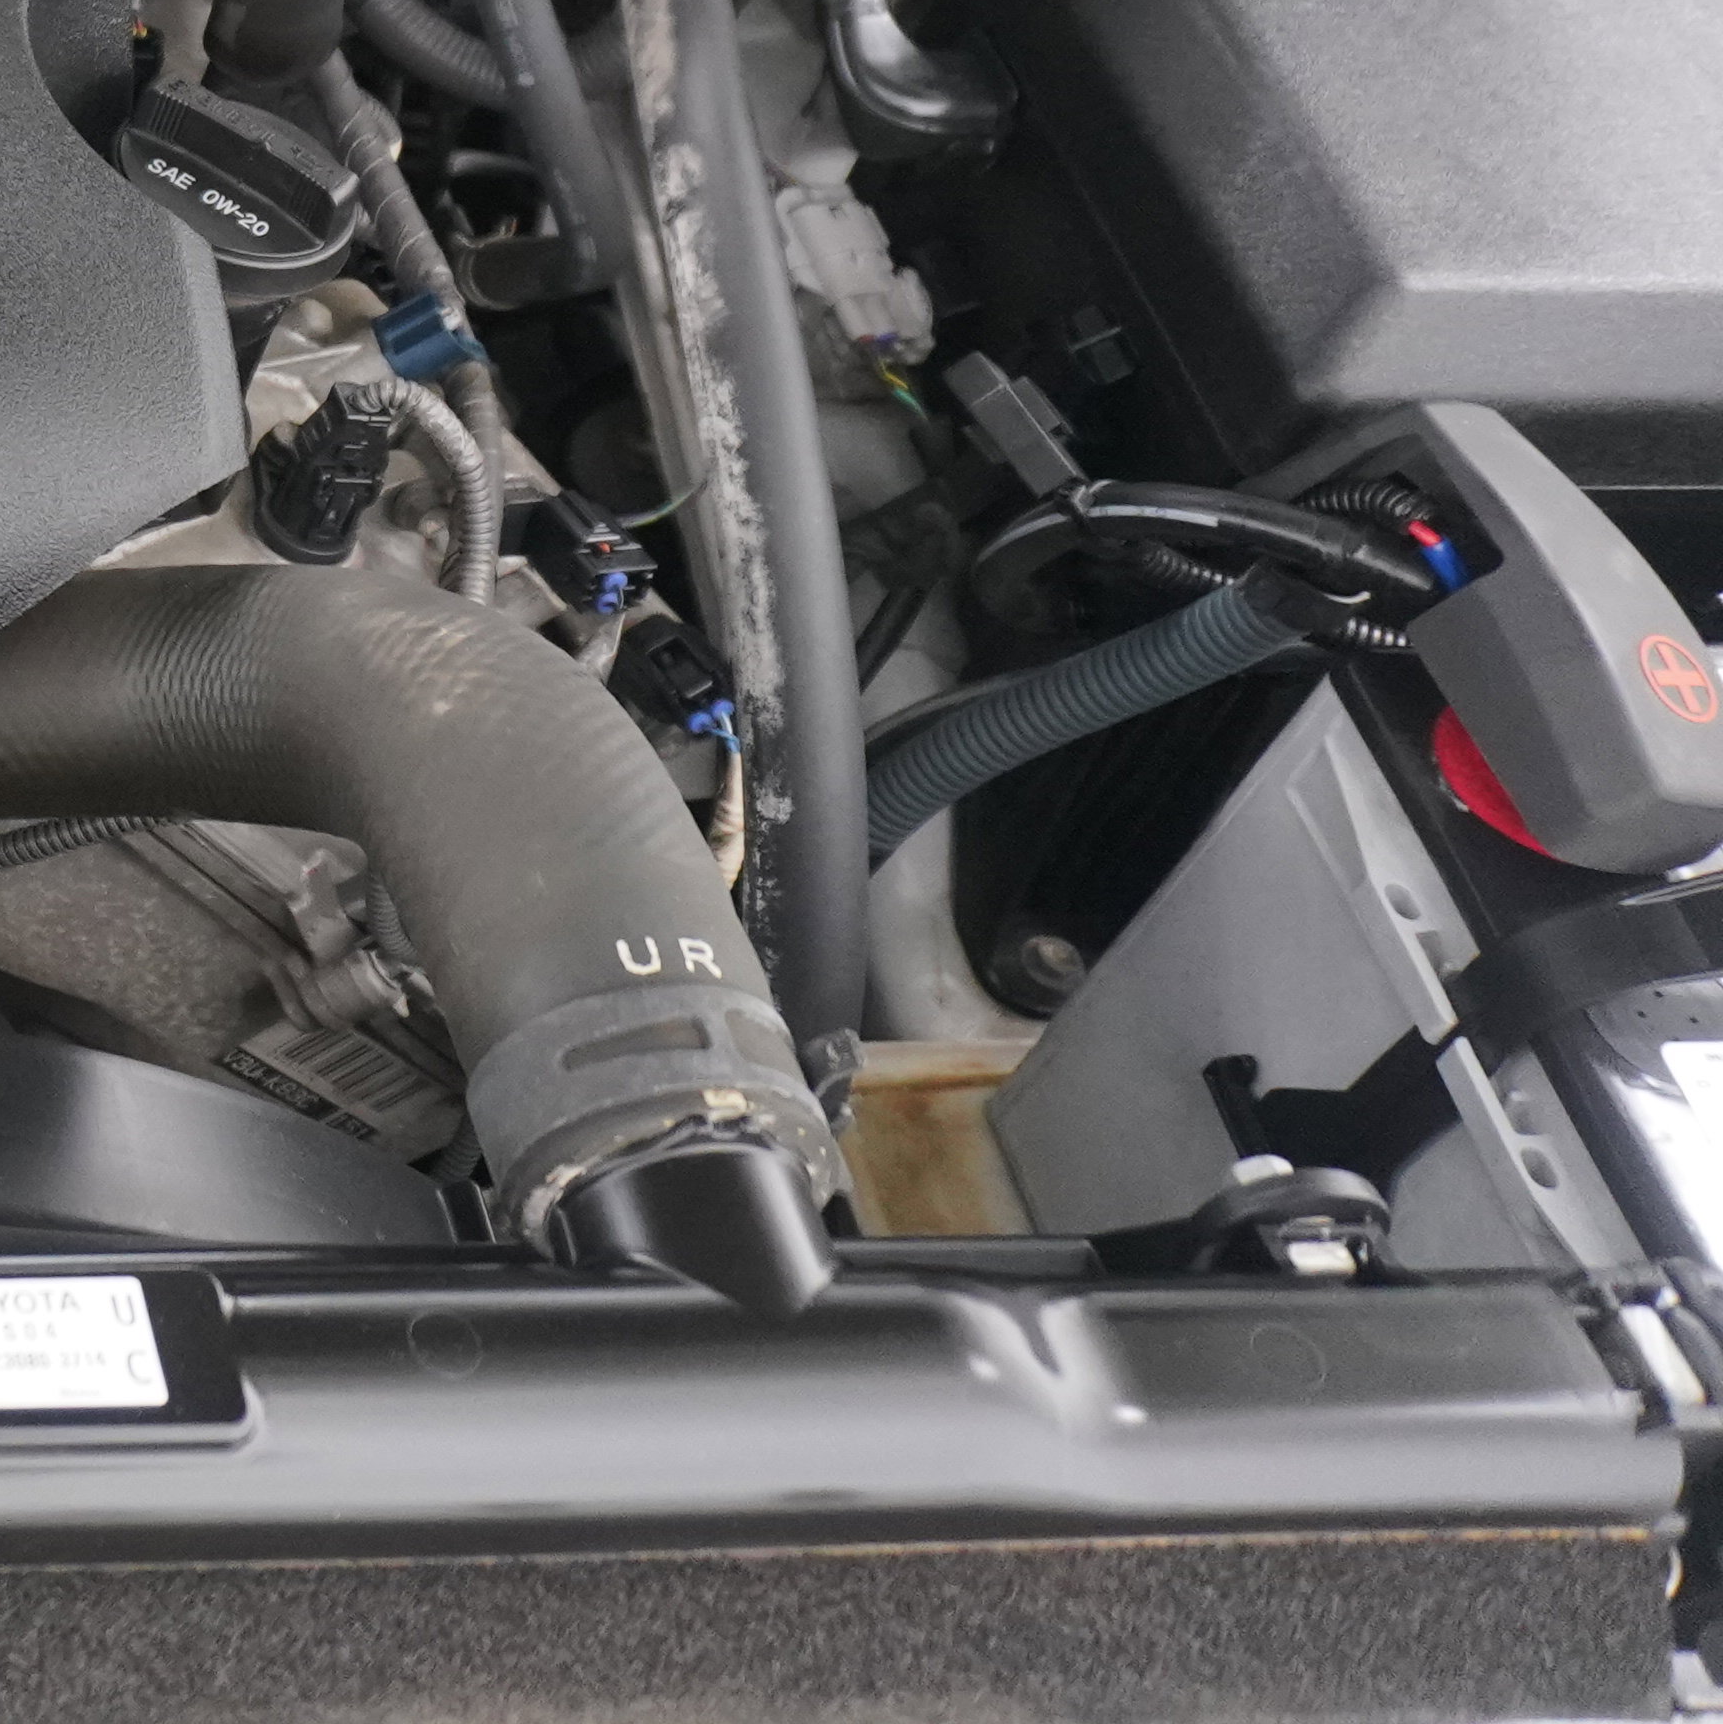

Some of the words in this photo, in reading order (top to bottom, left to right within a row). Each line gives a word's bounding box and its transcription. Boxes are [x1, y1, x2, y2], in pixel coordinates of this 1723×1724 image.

[147, 158, 196, 191] SAE
[201, 189, 270, 237] 0W-20
[110, 1292, 137, 1327] U
[126, 1350, 154, 1386] C
